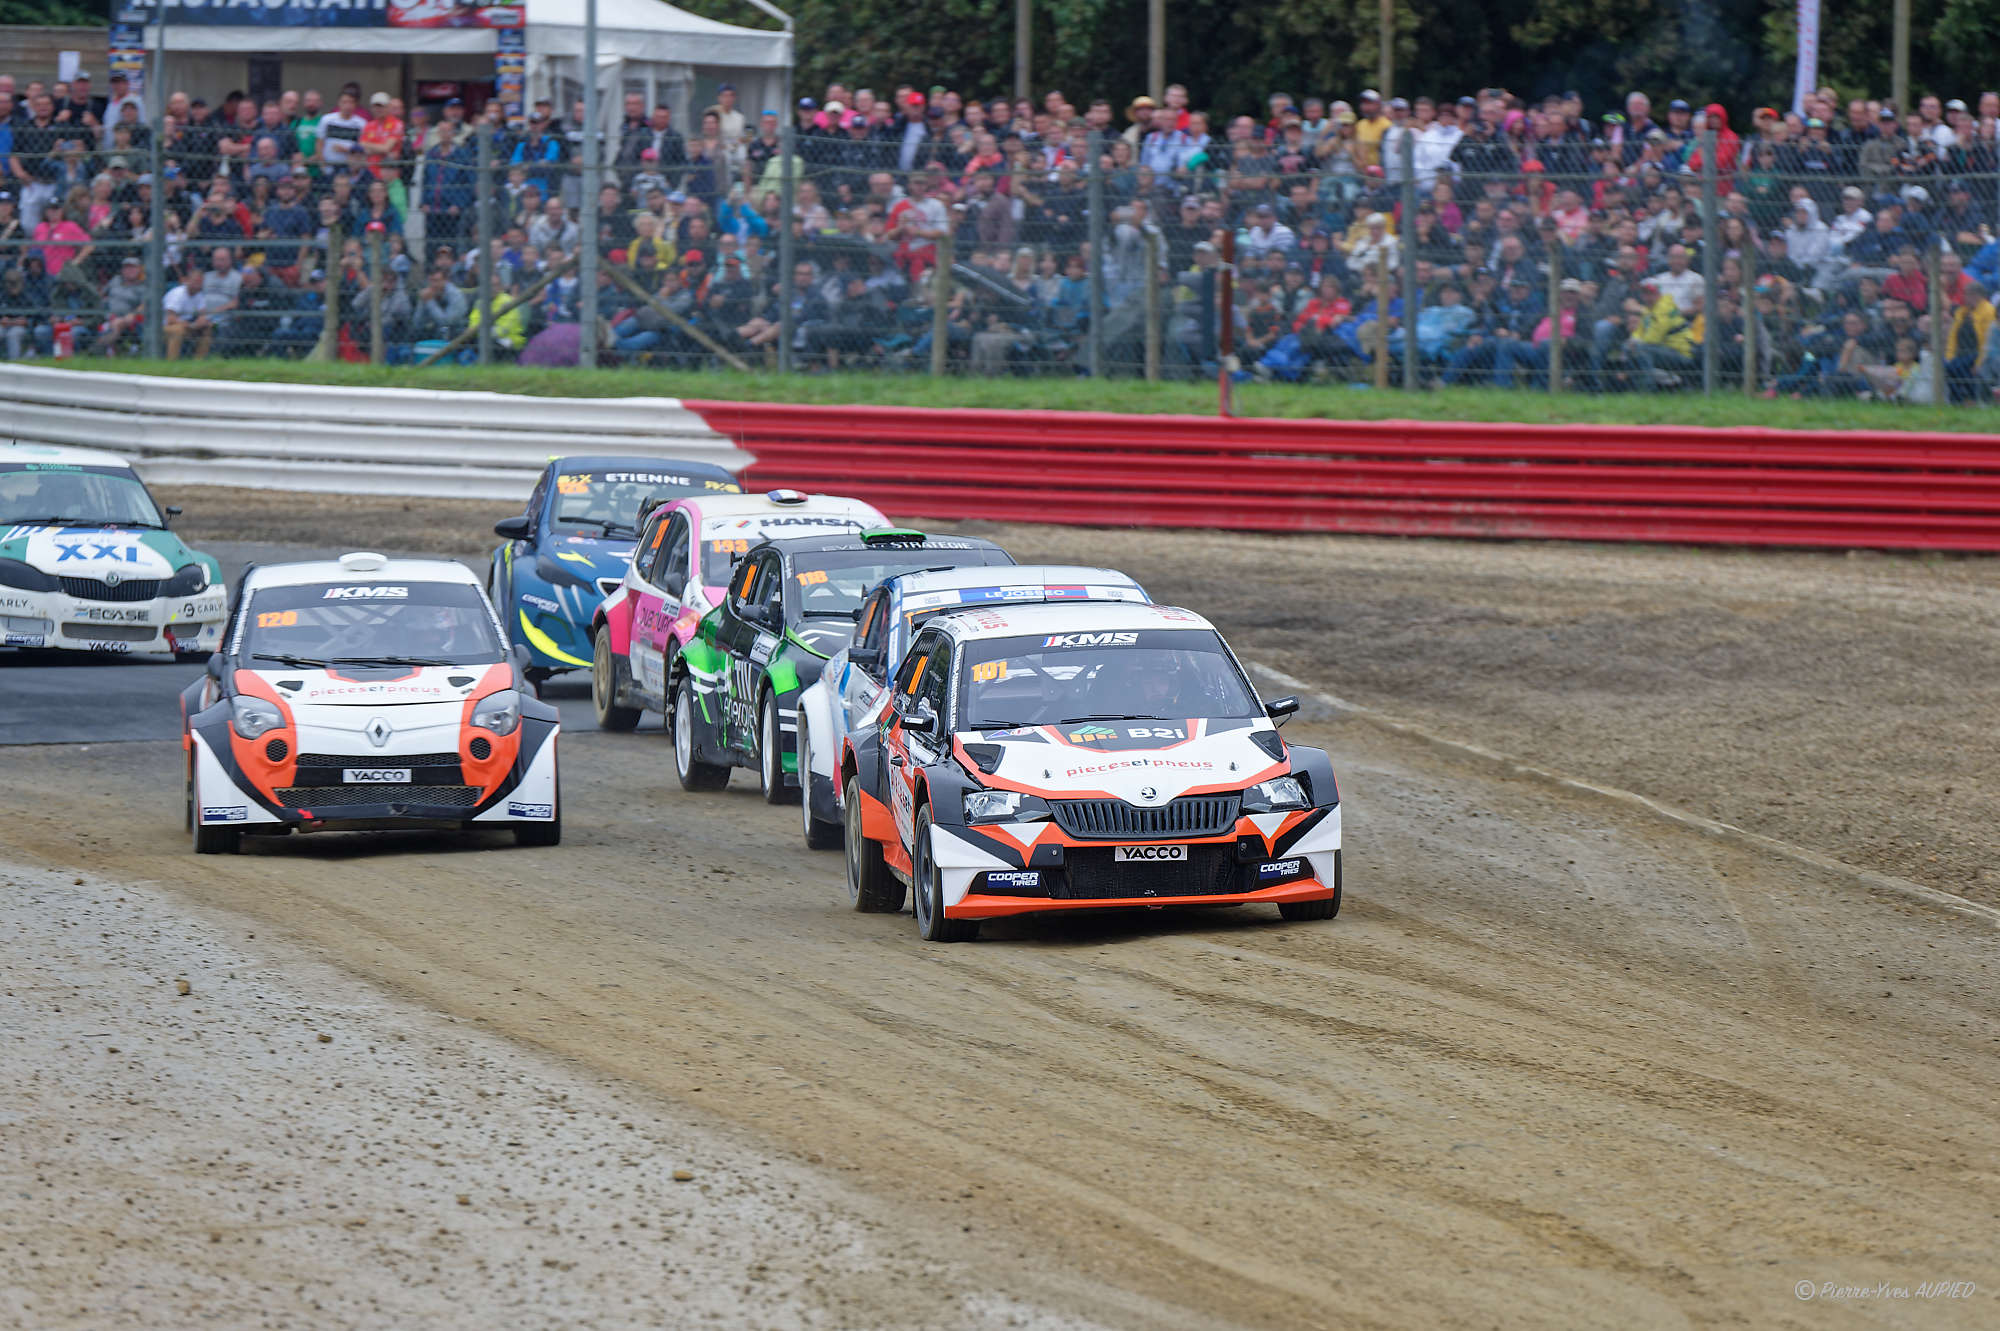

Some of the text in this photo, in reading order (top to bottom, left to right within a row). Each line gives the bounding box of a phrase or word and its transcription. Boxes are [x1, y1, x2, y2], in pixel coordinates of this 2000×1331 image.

[605, 473, 691, 485] ETIENNE
[54, 544, 137, 562] XXI
[796, 571, 829, 586] 118
[333, 586, 409, 599] KMS
[88, 608, 149, 622] ECASE
[257, 611, 298, 628] 120
[1050, 632, 1139, 647] KMS
[972, 661, 1008, 681] 101
[352, 771, 405, 783] YACCO
[1121, 846, 1181, 860] YACCO
[1260, 861, 1300, 875] COOPER
[988, 872, 1039, 881] COOPER
